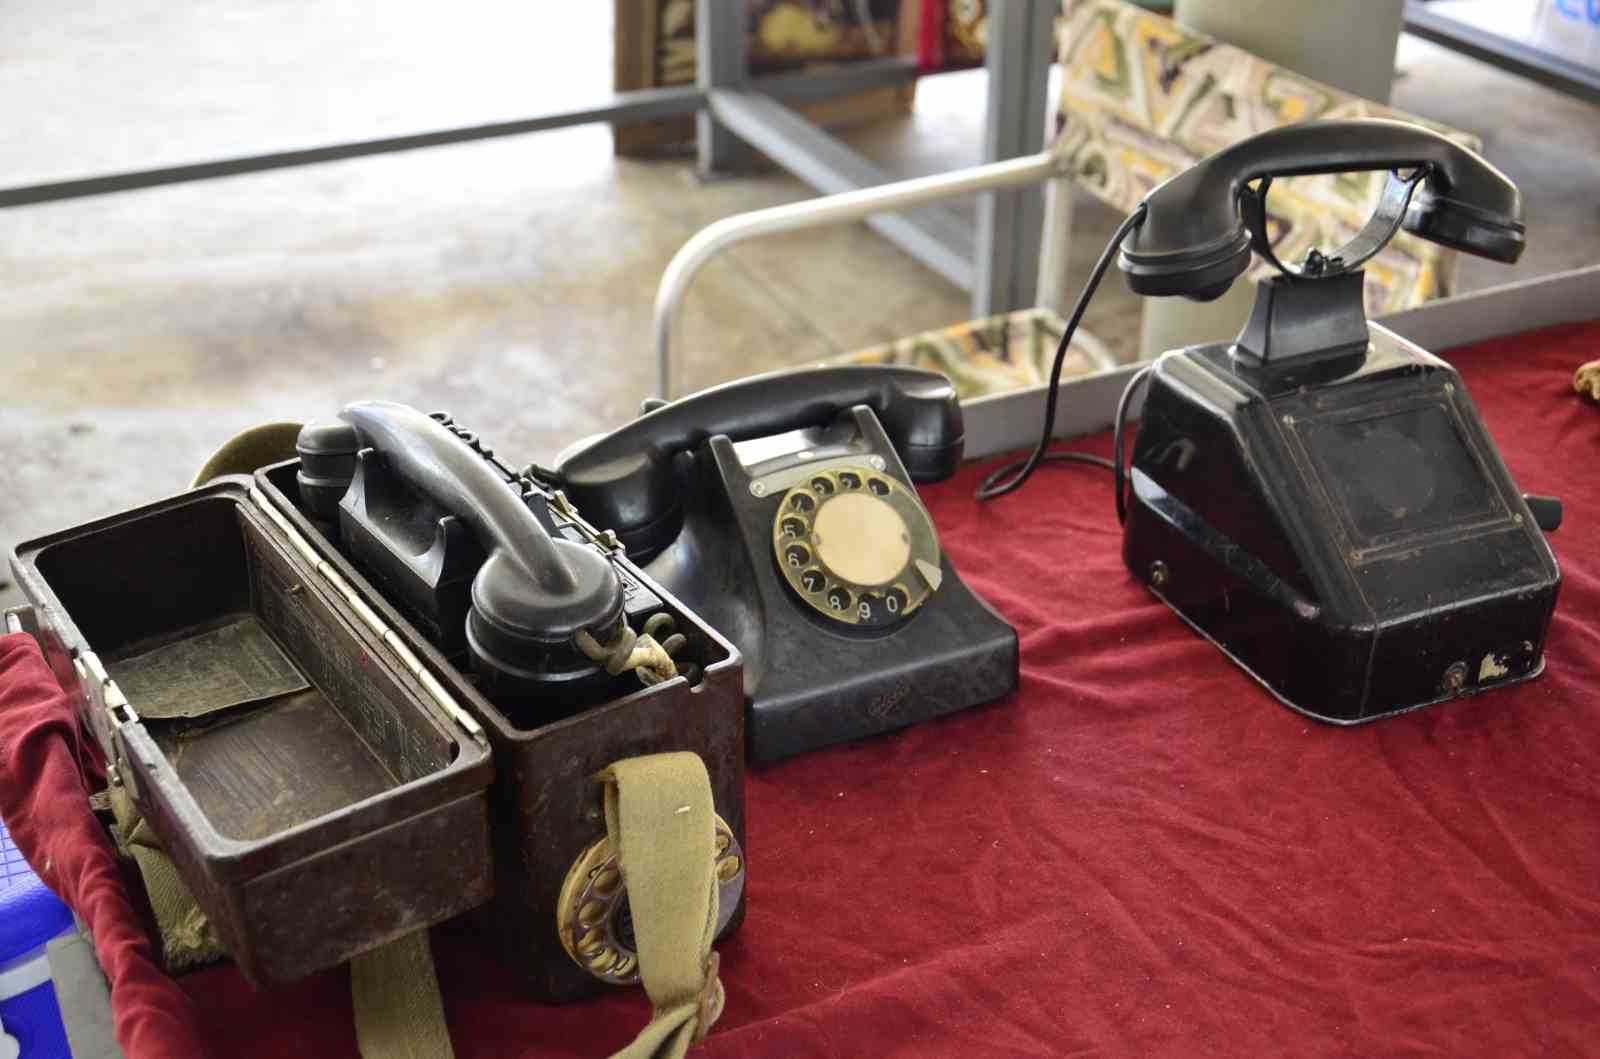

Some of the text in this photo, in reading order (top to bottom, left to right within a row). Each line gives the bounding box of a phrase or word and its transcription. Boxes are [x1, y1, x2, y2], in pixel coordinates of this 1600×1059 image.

[784, 524, 796, 538] 5
[788, 553, 800, 567] 6
[803, 578, 815, 592] 7
[830, 595, 841, 610] 8
[886, 596, 898, 612] 0
[859, 602, 871, 618] 9
